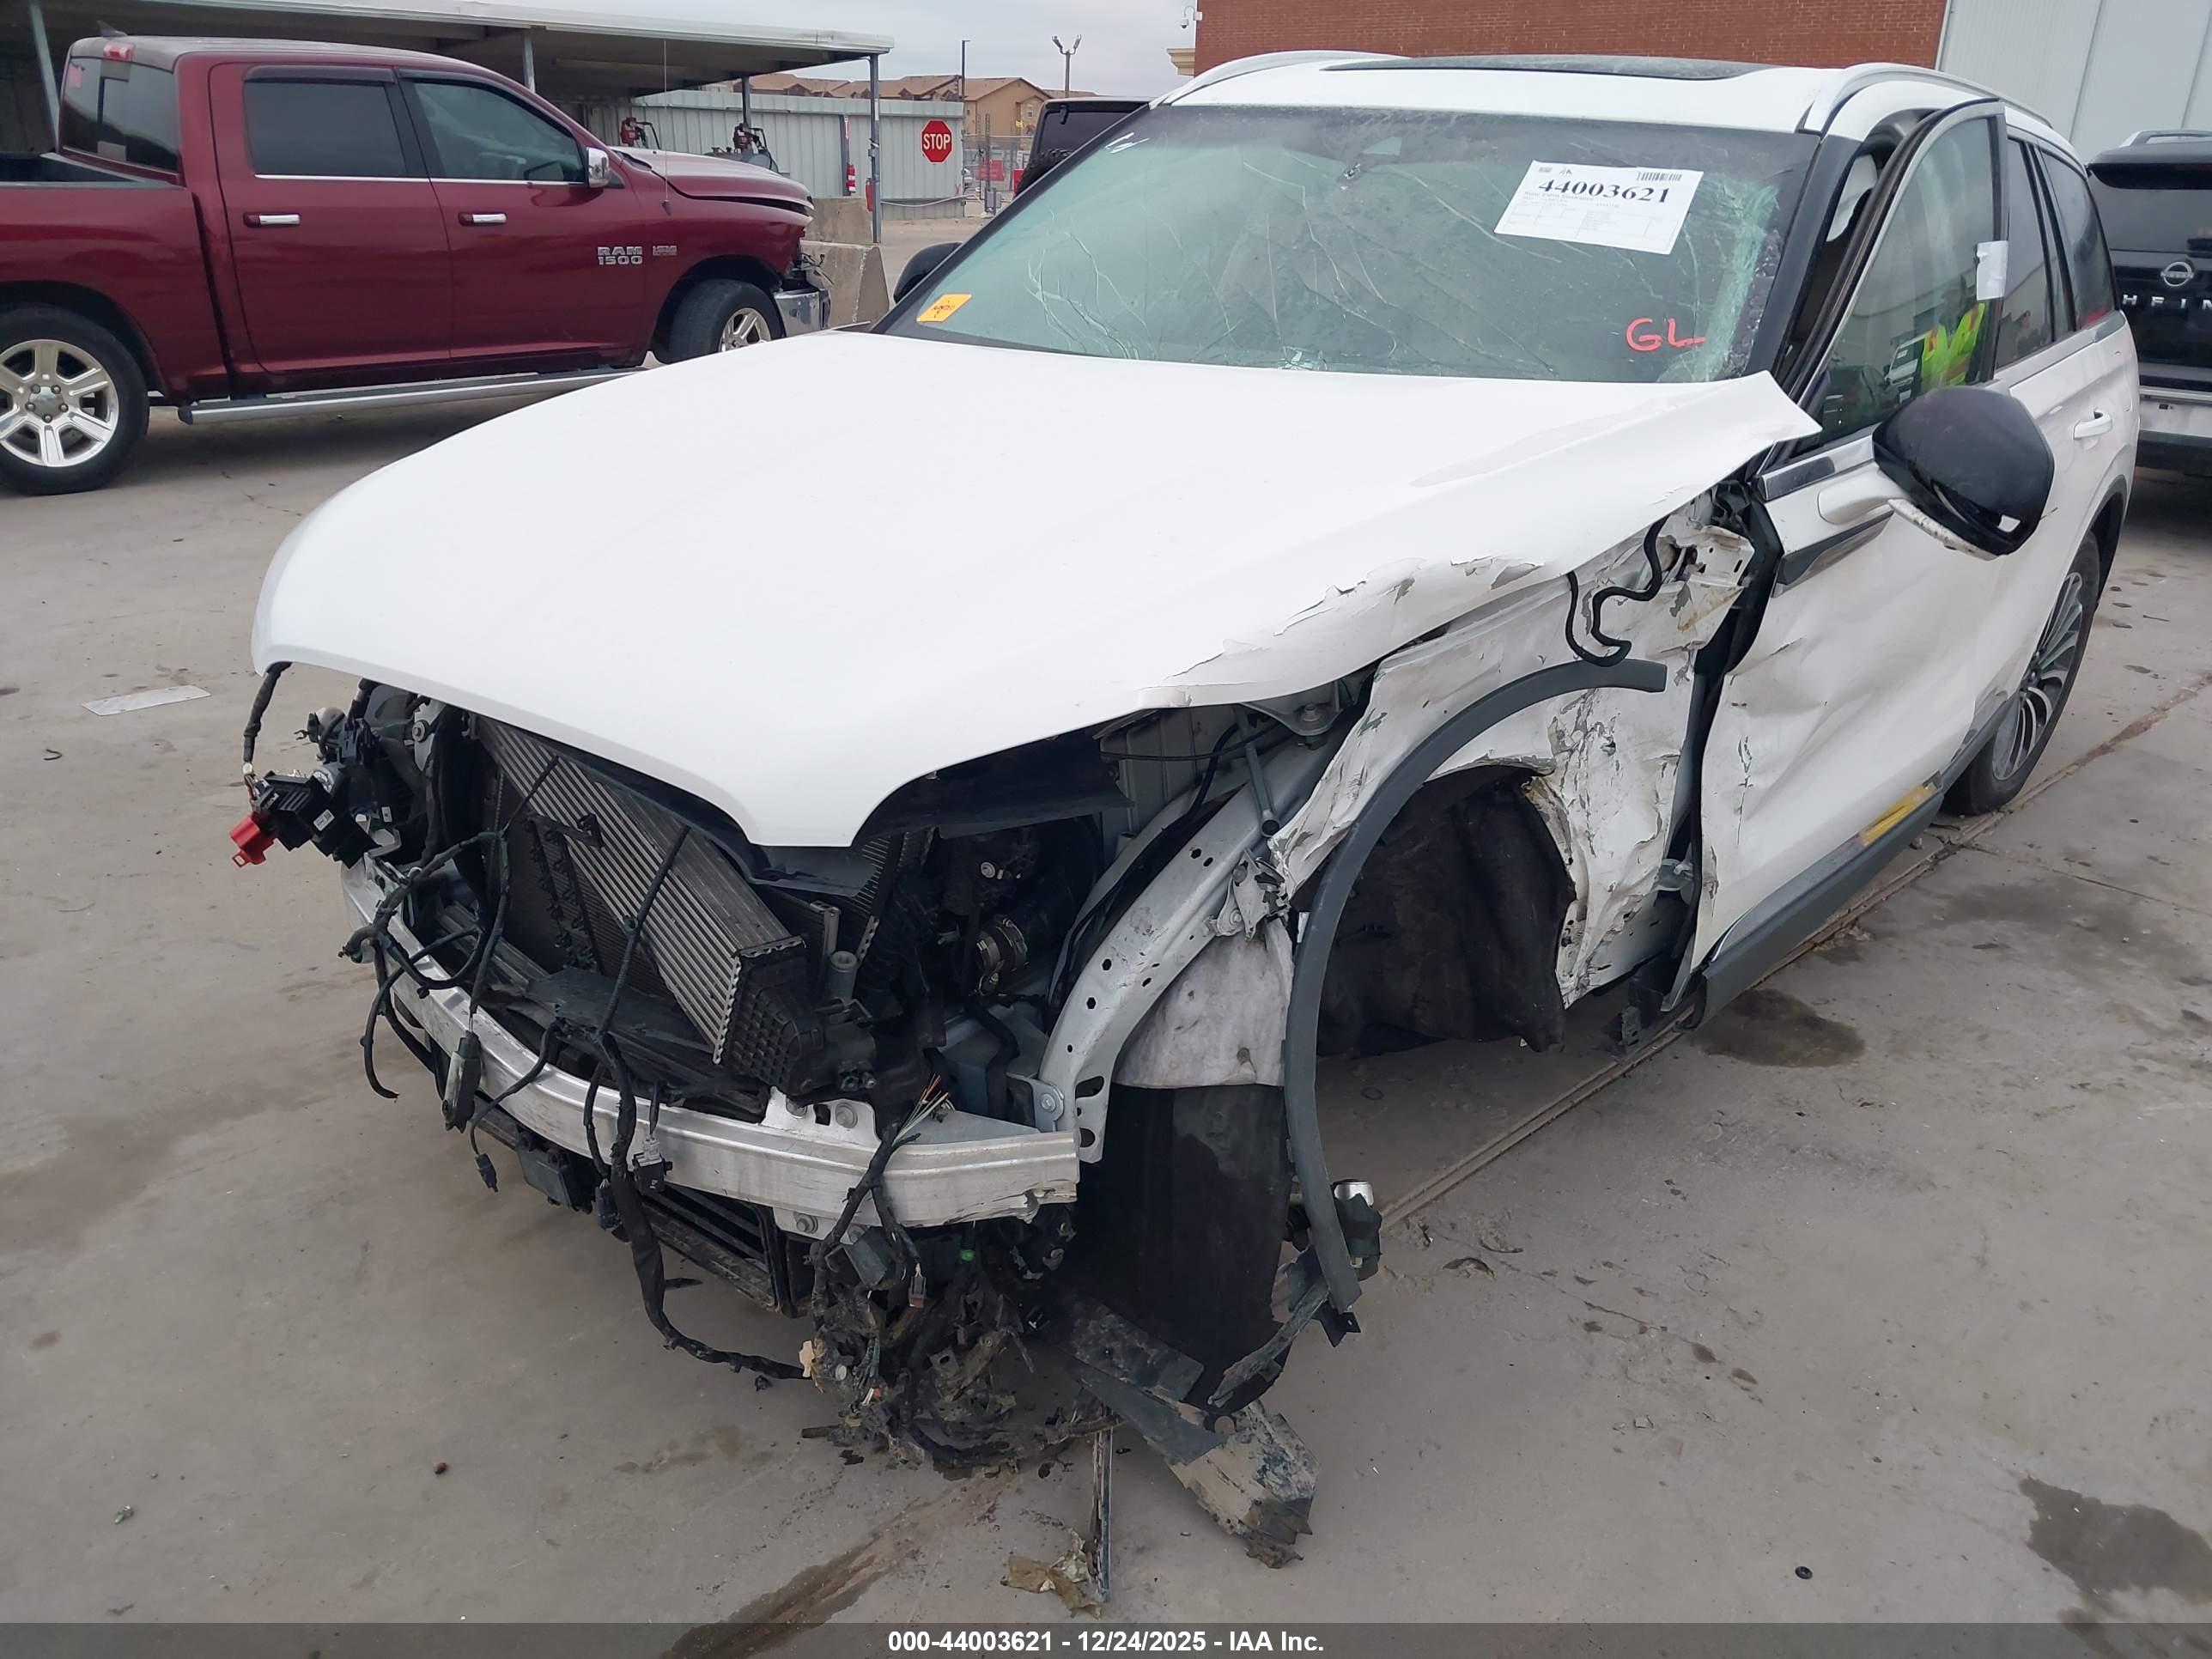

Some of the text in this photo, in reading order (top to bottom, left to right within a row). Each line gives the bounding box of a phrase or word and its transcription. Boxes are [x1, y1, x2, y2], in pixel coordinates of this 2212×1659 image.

[923, 133, 951, 150] STOP
[1538, 179, 1671, 204] 44003621
[597, 246, 643, 256] RAM
[597, 256, 643, 265] 1500
